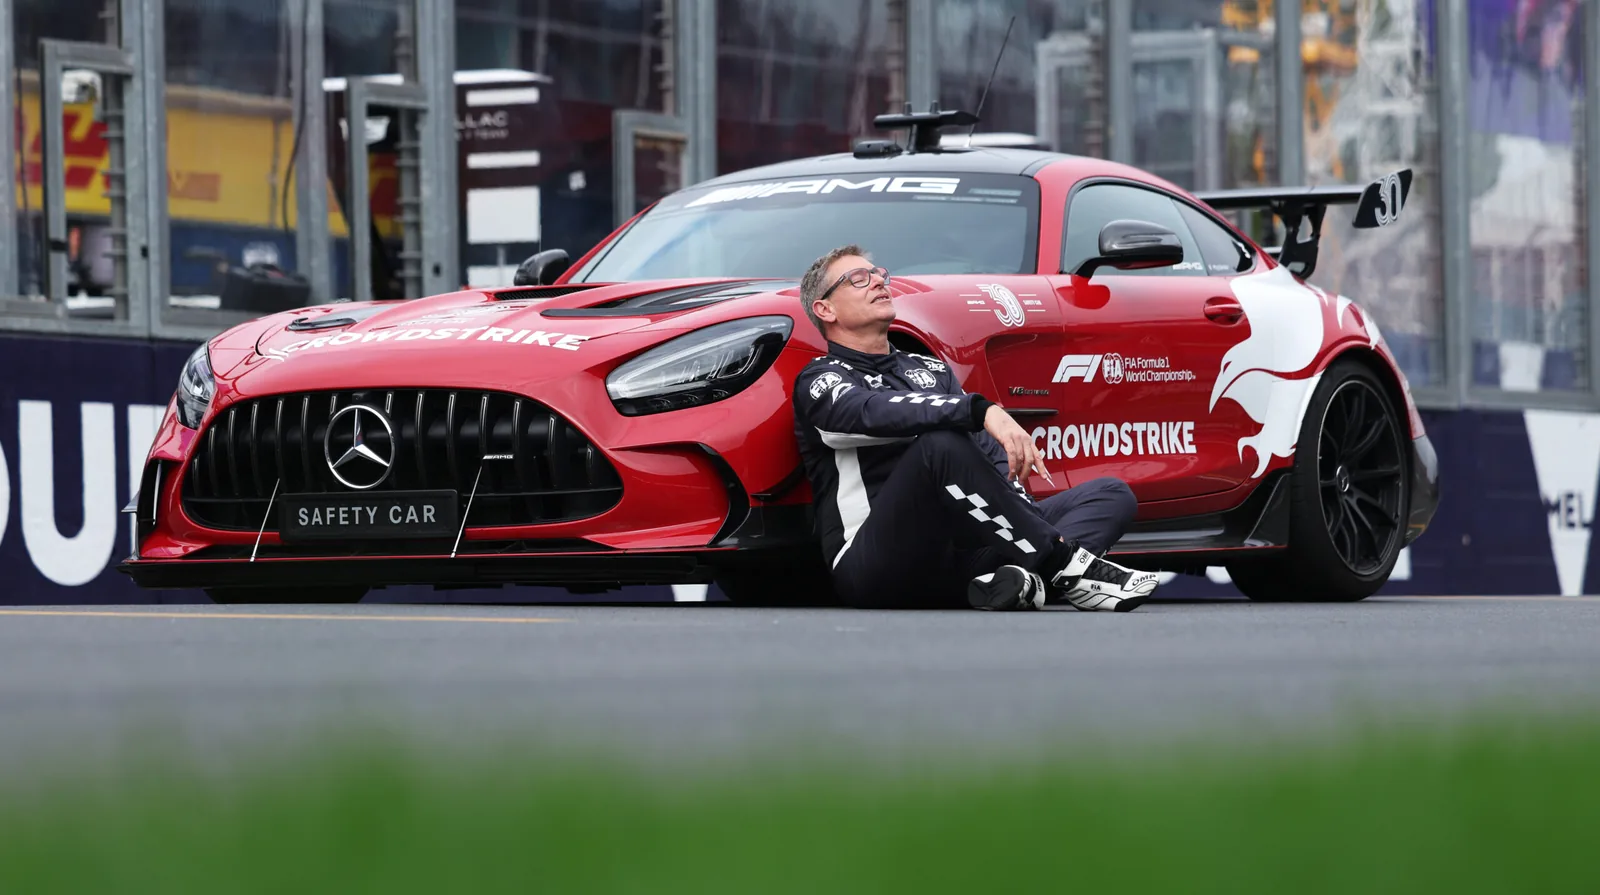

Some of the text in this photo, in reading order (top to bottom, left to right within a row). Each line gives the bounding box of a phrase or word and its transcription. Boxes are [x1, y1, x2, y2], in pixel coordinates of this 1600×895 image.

[1374, 173, 1402, 227] 30
[284, 327, 592, 353] CROWDSTRIKE
[1051, 354, 1103, 383] F1
[1103, 359, 1124, 379] FIA
[1125, 357, 1170, 369] FIA Formula 1
[1125, 369, 1193, 383] World Championship
[1031, 421, 1197, 460] CROWDSTRIKE
[298, 505, 436, 526] SAFETY CAR
[1132, 574, 1156, 587] OMP
